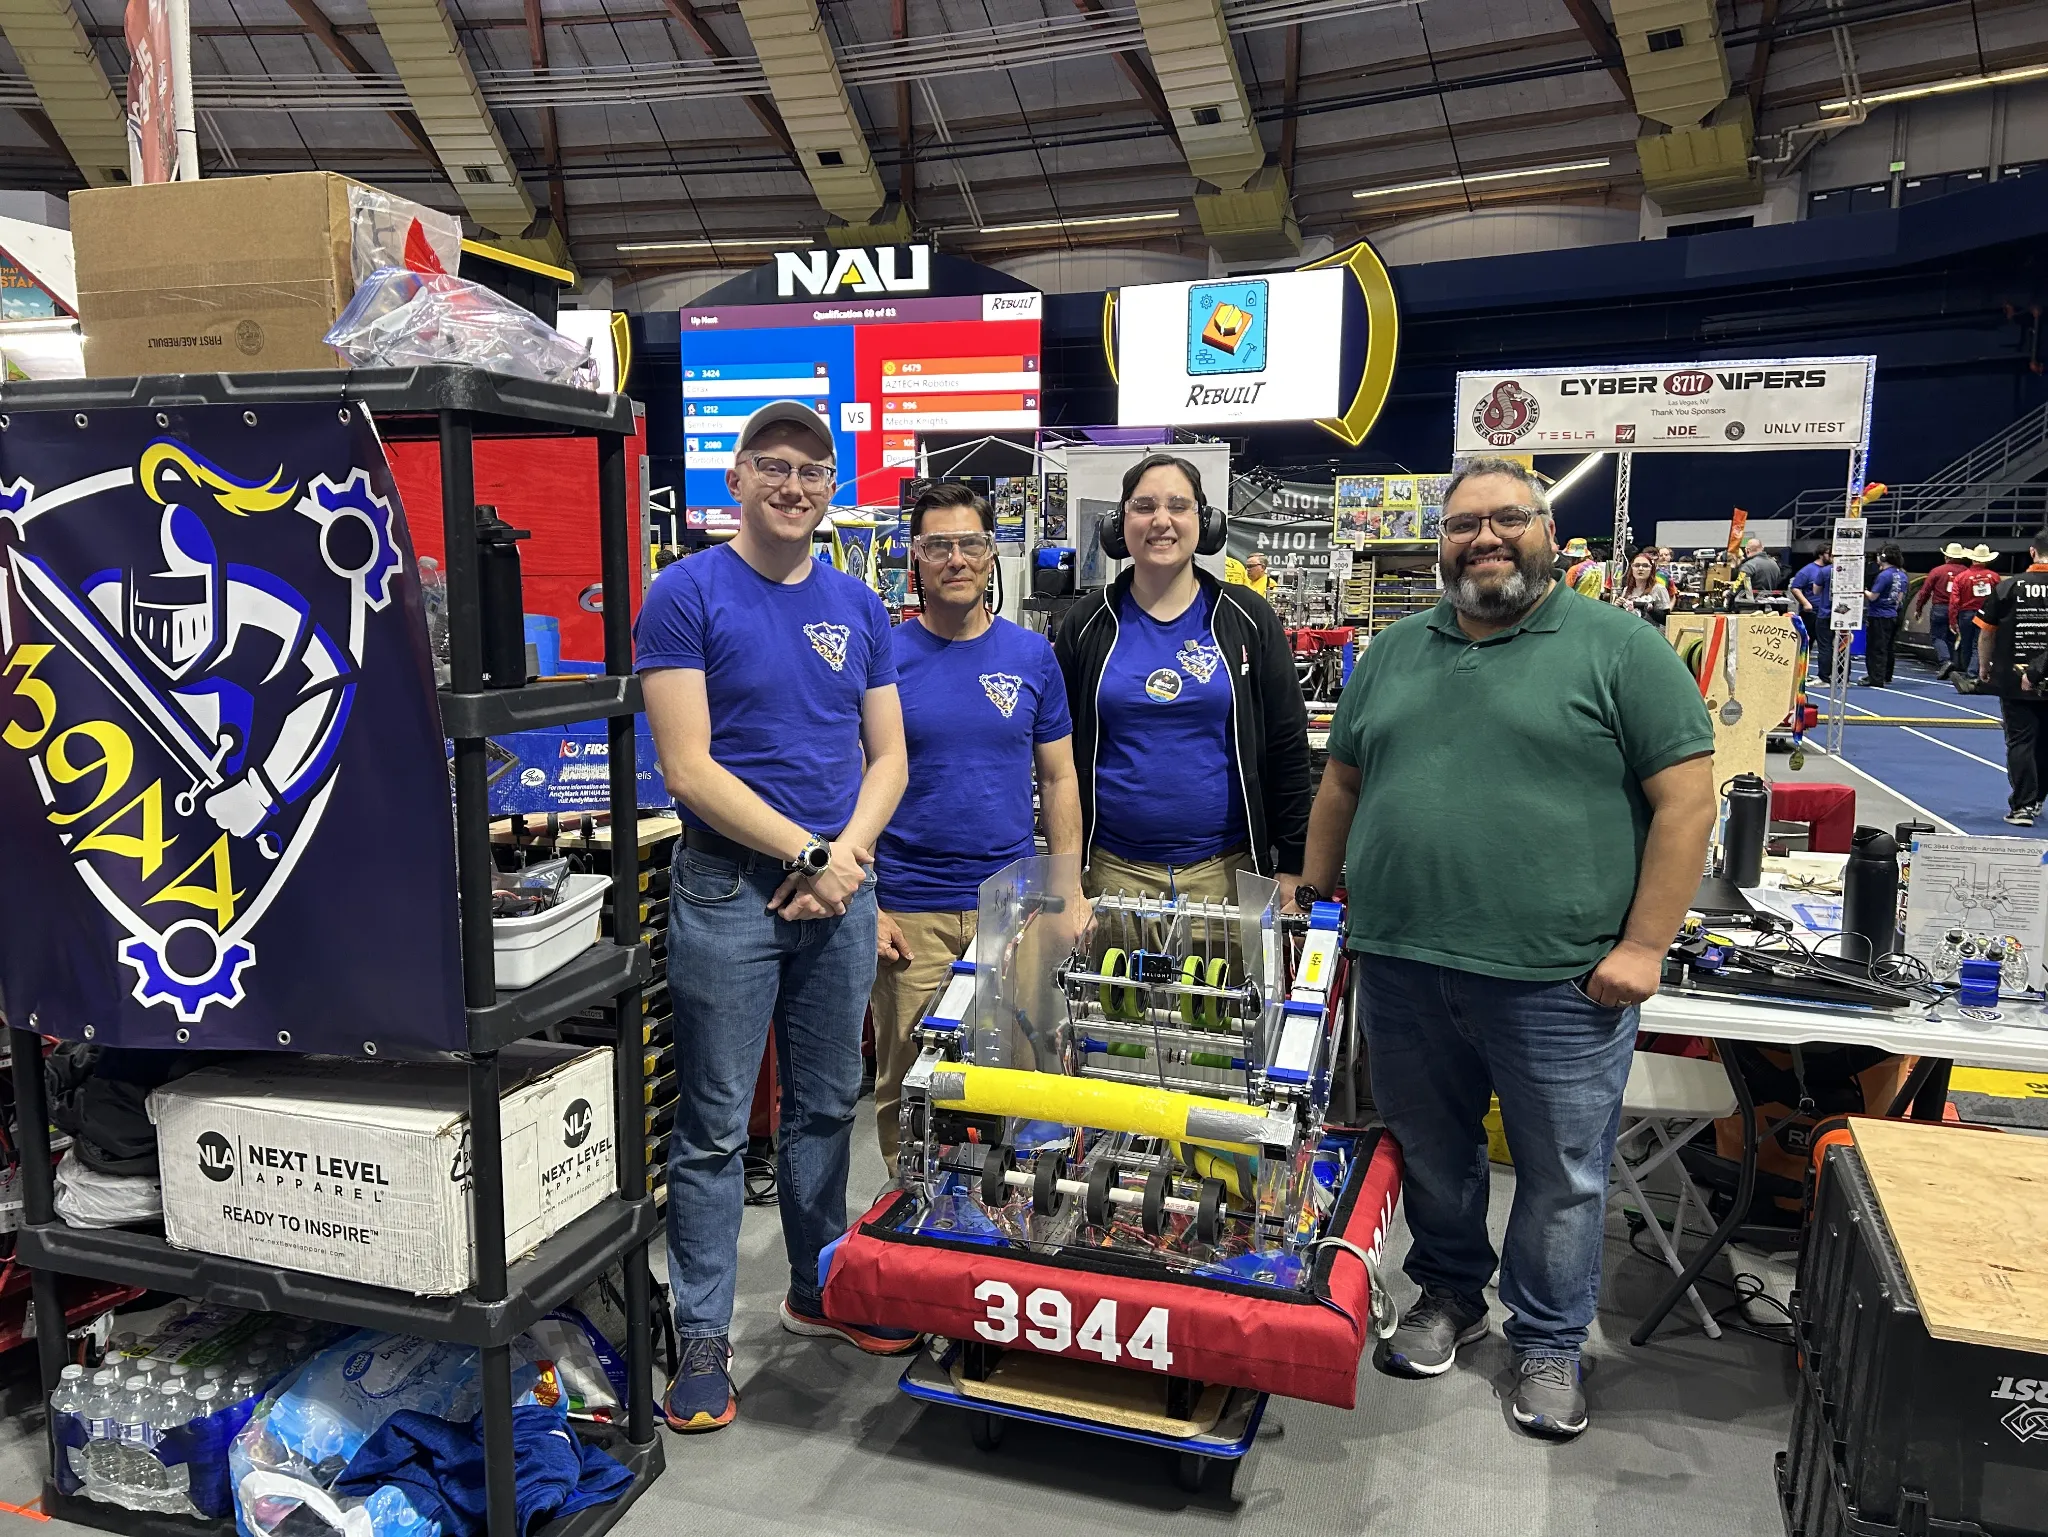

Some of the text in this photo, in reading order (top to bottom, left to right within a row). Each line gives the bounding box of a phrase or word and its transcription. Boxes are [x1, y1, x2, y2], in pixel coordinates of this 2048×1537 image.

[774, 245, 930, 297] NAU
[992, 296, 1036, 311] REBUILT
[812, 309, 863, 321] Qualification
[875, 308, 884, 317] of
[147, 335, 223, 348] FIRST AGE/REBUILT
[701, 369, 720, 378] 3424
[902, 364, 922, 372] 6479
[885, 379, 959, 388] AZTECH Robotics
[1560, 369, 1826, 396] CYBER 8717 VIPERS
[1185, 381, 1267, 407] REBUILT
[702, 405, 719, 414] 1212
[902, 401, 917, 410] 996
[1651, 407, 1726, 417] Thank You Sponsors
[848, 411, 864, 424] VS
[916, 417, 948, 427] Knights
[1472, 399, 1491, 438] CYBER
[1667, 425, 1697, 436] NDE
[1764, 422, 1845, 434] UNLV ITEST
[1491, 433, 1512, 445] 8717
[1537, 430, 1595, 441] TESLA
[2025, 584, 2048, 598] 101
[1748, 624, 1799, 642] SHOOTER
[1766, 636, 1782, 650] V3
[1752, 645, 1790, 667] 2/13/26
[583, 743, 609, 755] FIRS
[1, 644, 247, 932] 3944
[580, 1009, 602, 1018] ectors
[563, 1106, 593, 1138] NLA
[197, 1144, 235, 1169] NLA
[541, 1137, 613, 1187] NEXT LEVEL
[248, 1144, 389, 1186] NEXT LEVEL
[222, 1204, 274, 1227] READY
[278, 1213, 300, 1232] TO
[973, 1279, 1174, 1371] 3944
[344, 1351, 367, 1378] Great
